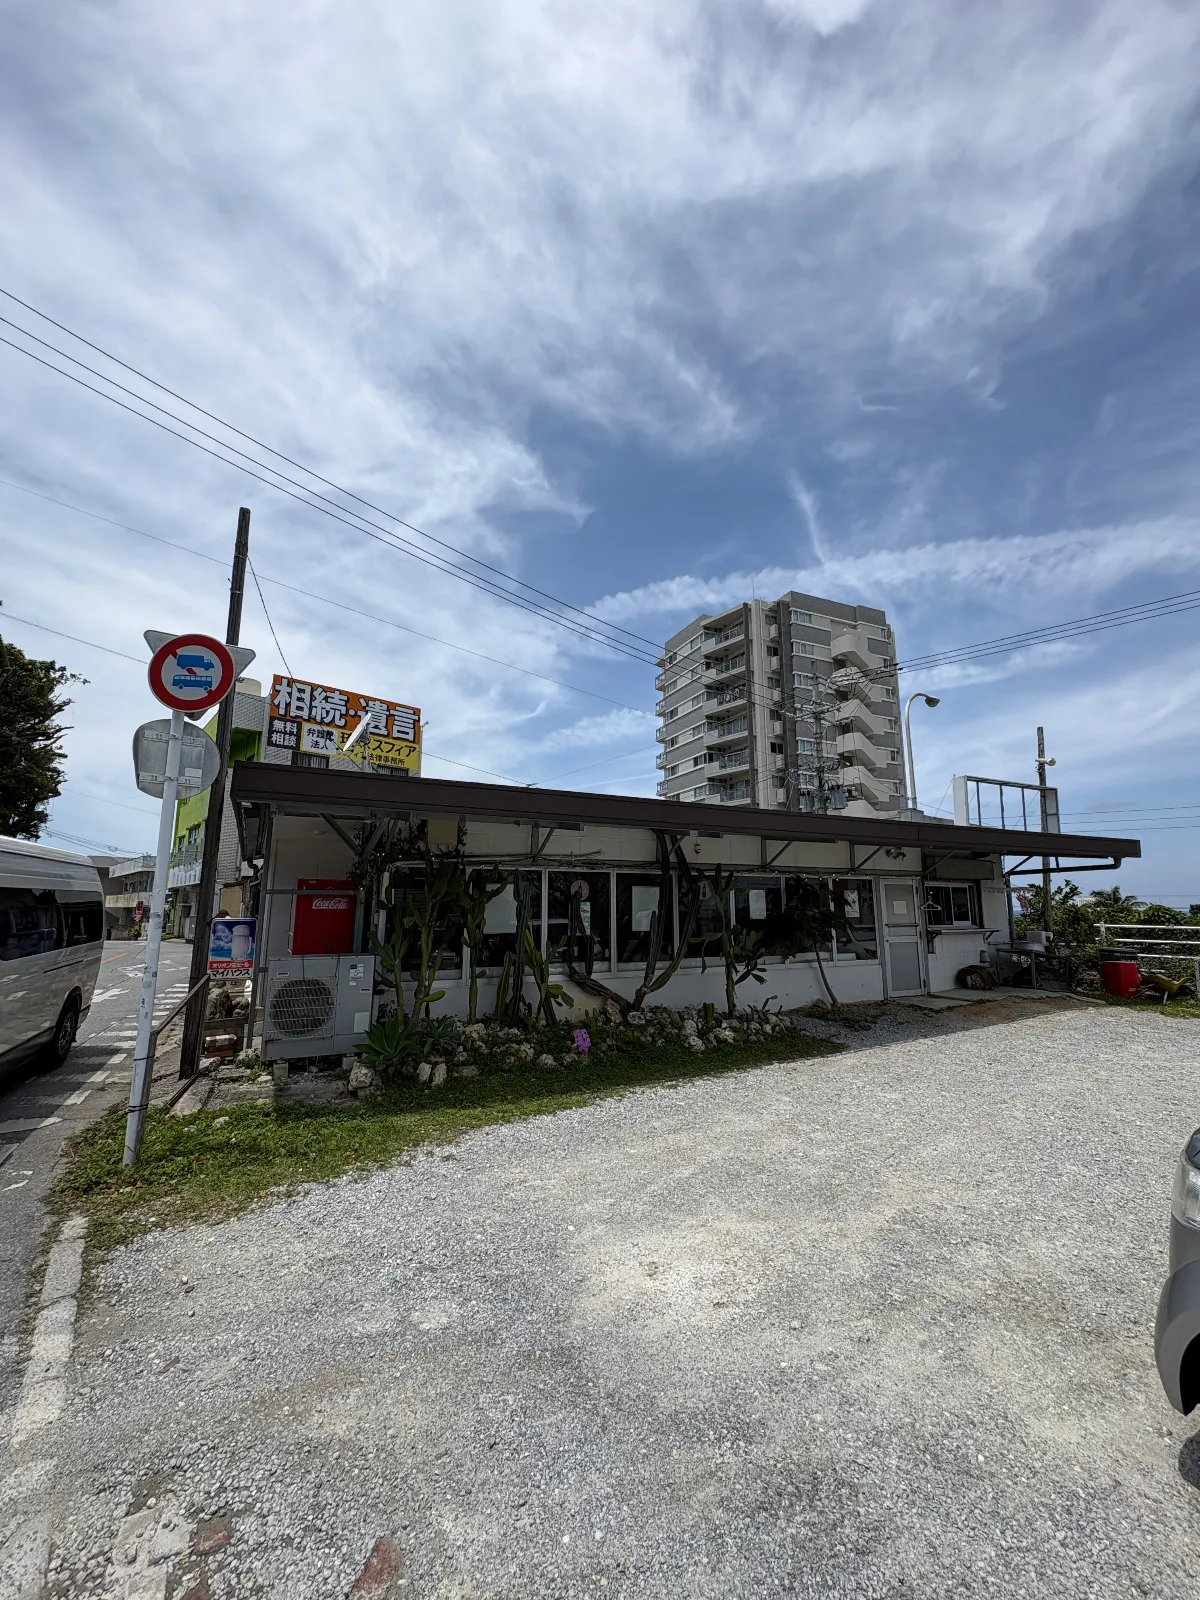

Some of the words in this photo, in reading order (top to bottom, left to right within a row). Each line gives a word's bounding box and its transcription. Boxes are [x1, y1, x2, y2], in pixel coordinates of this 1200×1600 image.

[272, 678, 419, 742] 相続・遺言
[272, 719, 298, 735] 無料
[270, 732, 297, 748] 相談
[210, 968, 251, 978] マイハウス
